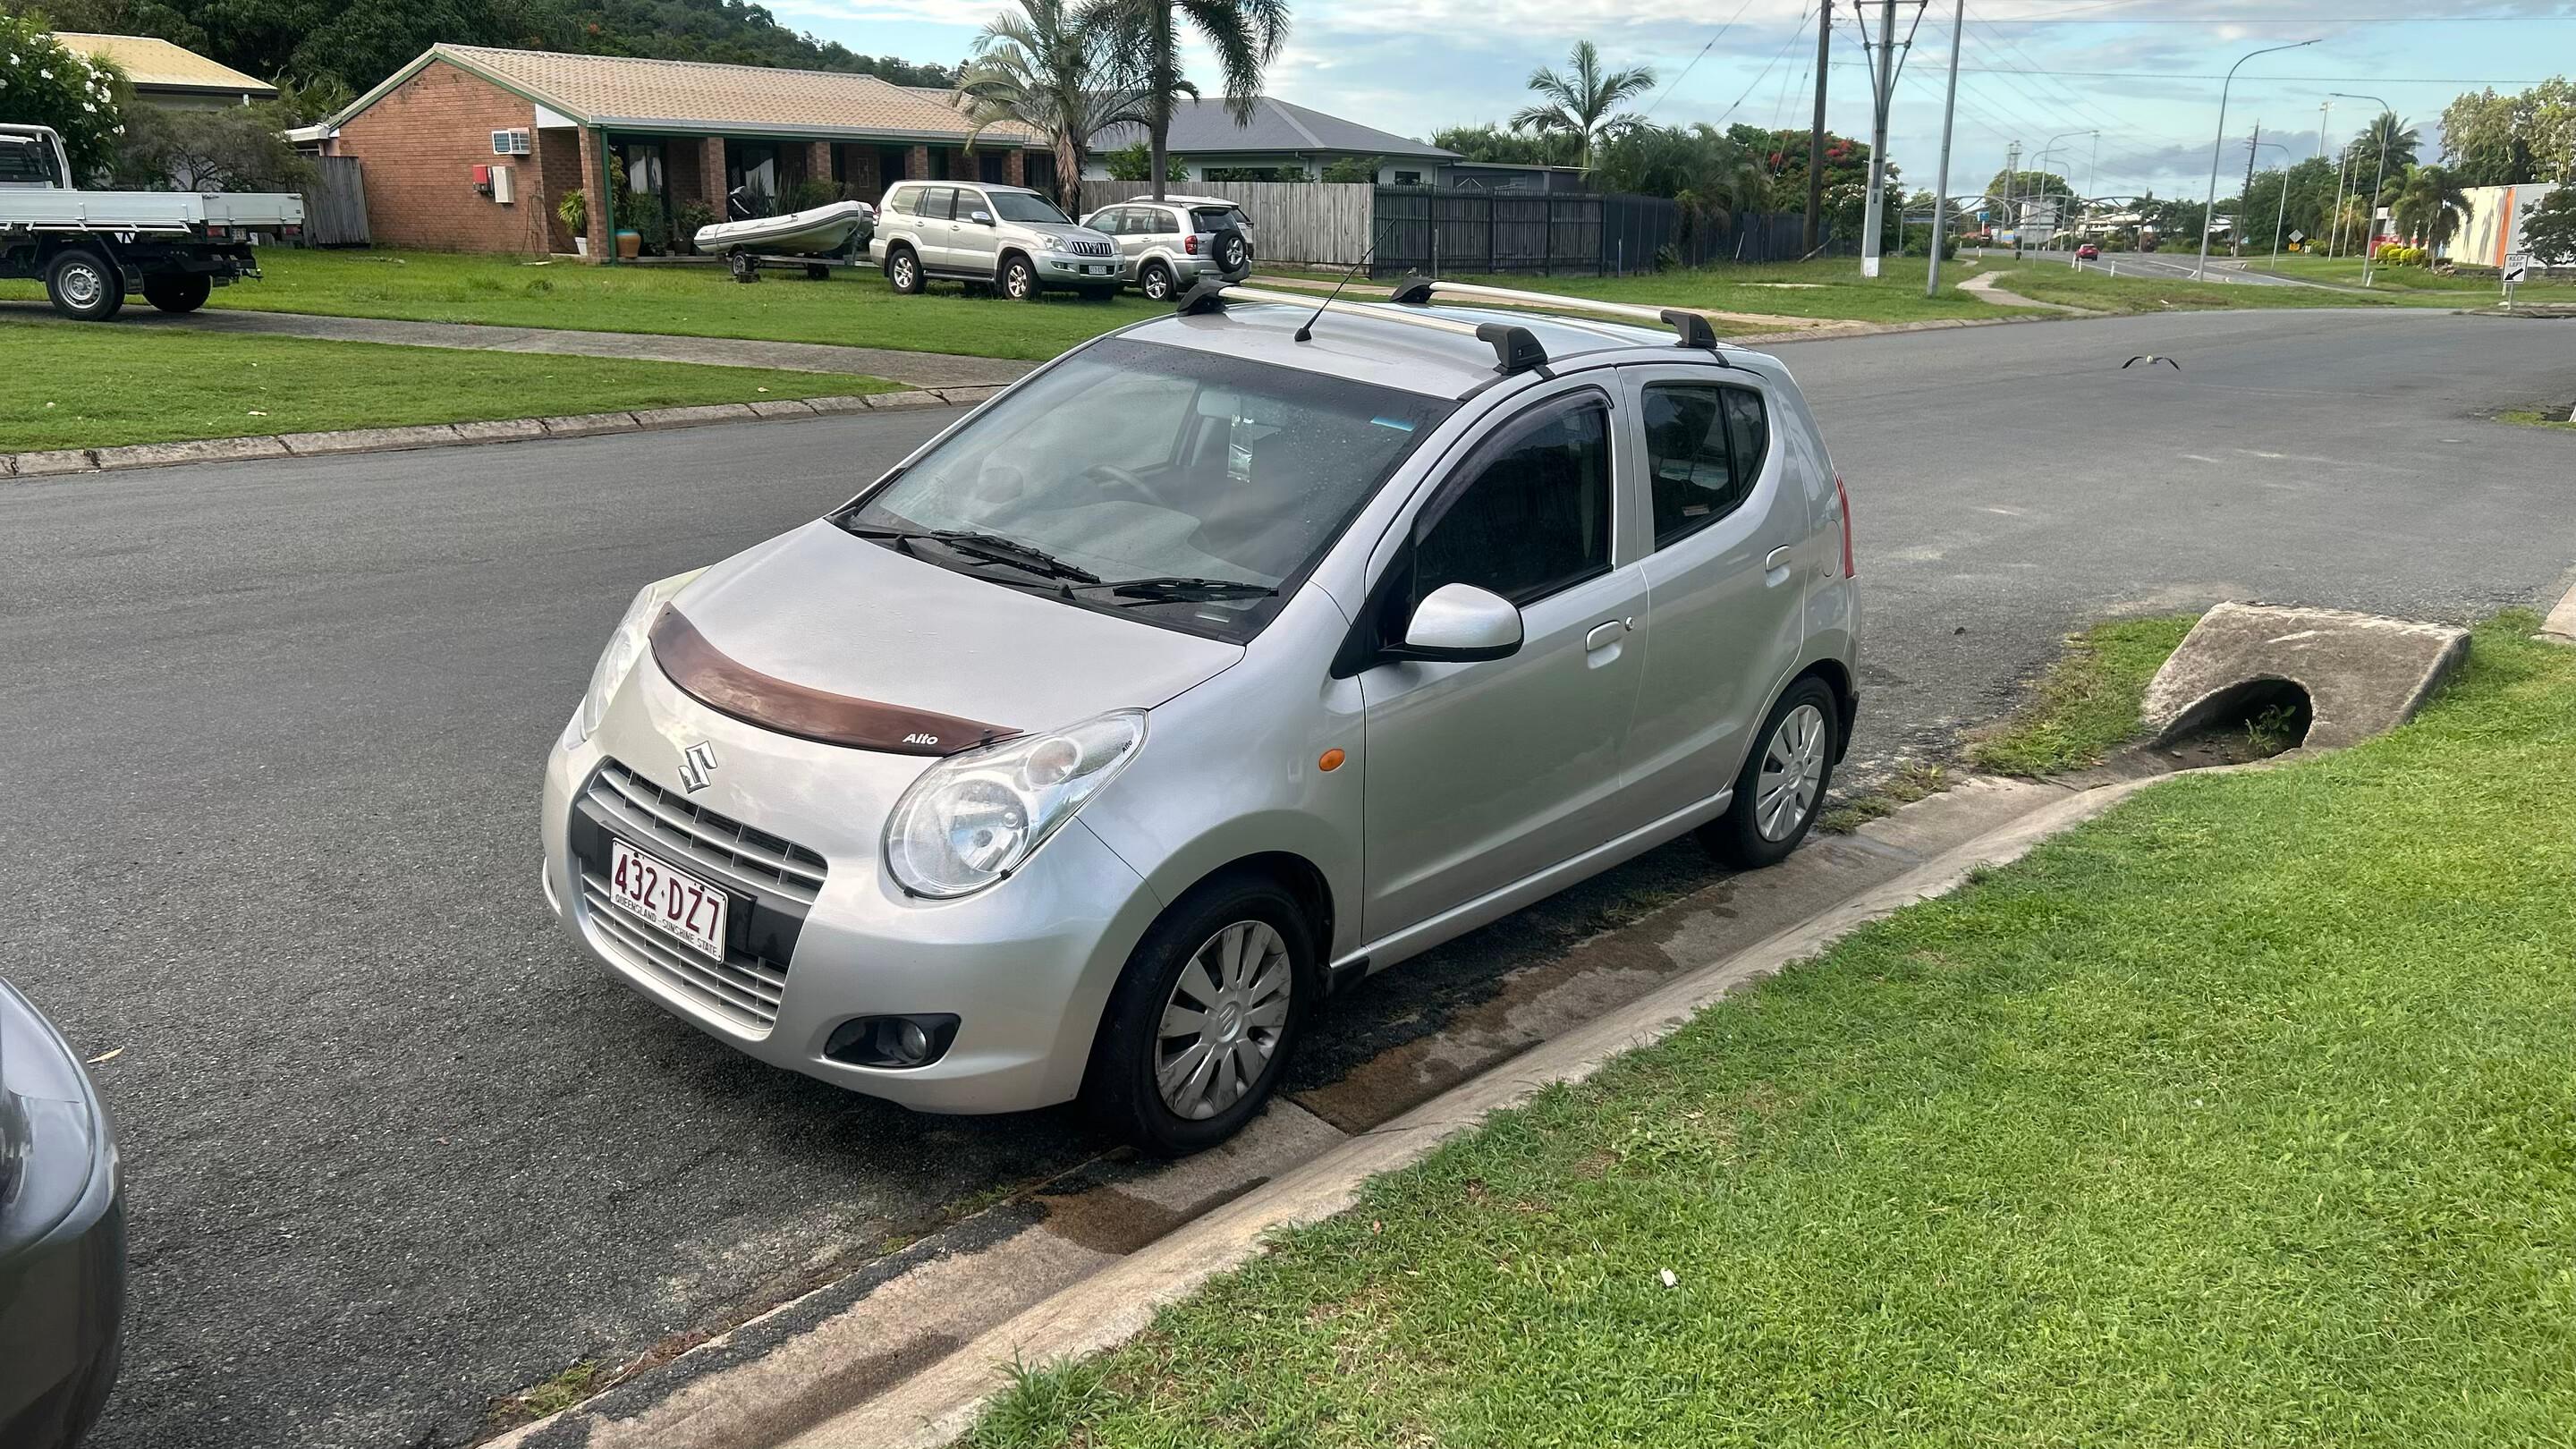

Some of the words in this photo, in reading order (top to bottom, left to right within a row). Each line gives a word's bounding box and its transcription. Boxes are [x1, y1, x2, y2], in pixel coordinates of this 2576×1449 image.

[902, 733, 938, 745] Alto
[1122, 740, 1132, 754] Alto
[615, 894, 657, 923] QUEENSLAND
[662, 919, 695, 944] SUNSHINE
[697, 937, 718, 956] STATE
